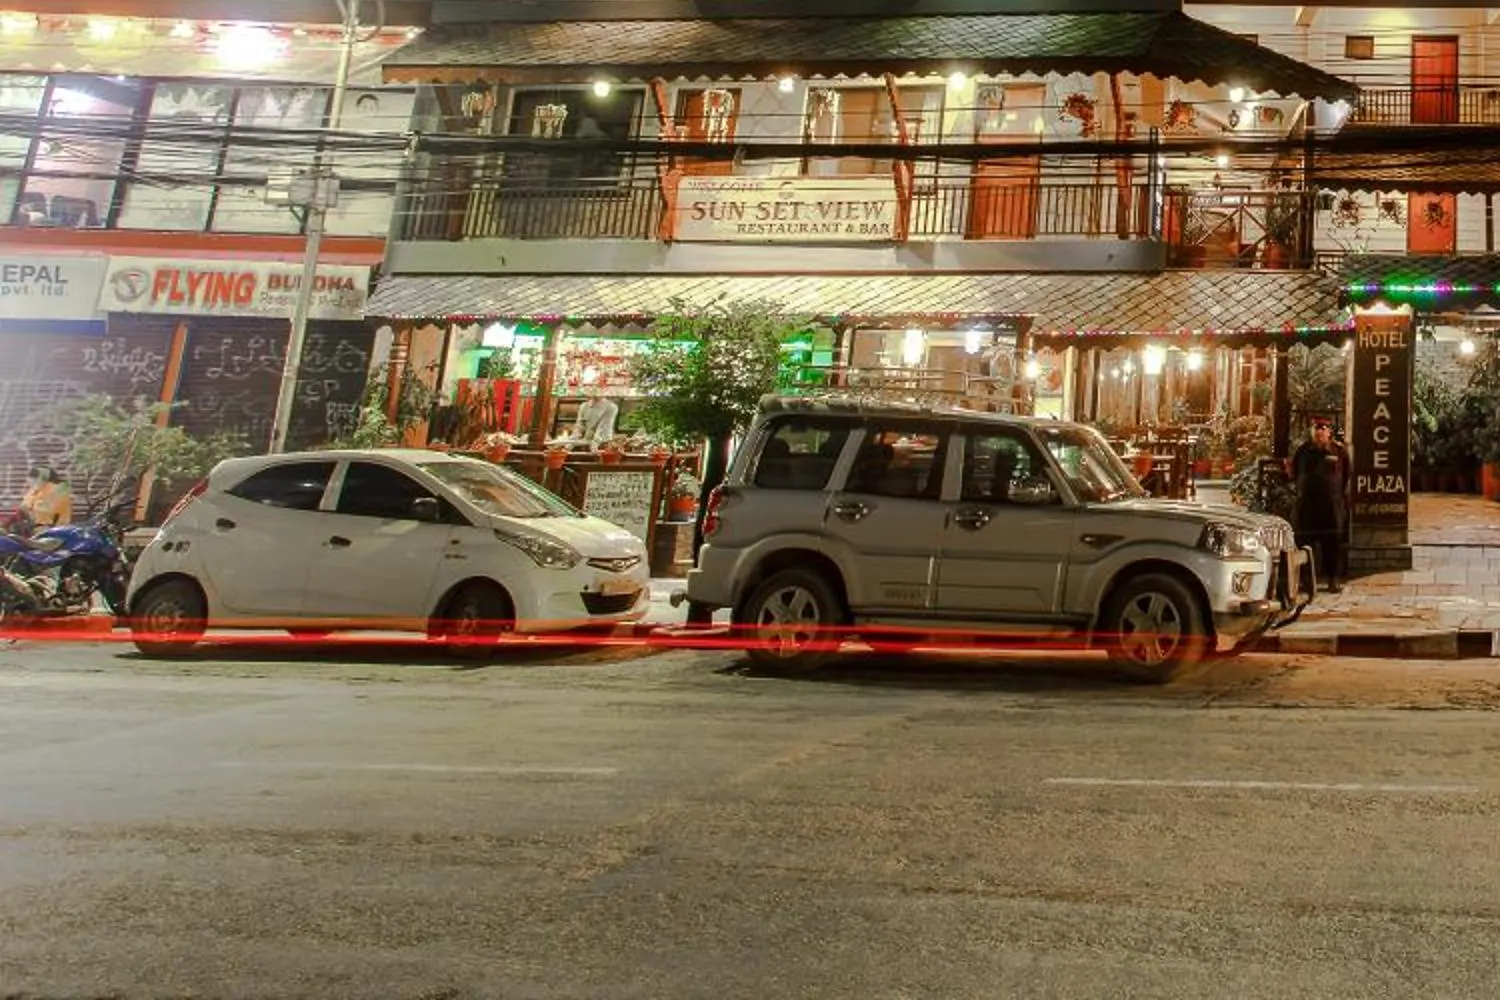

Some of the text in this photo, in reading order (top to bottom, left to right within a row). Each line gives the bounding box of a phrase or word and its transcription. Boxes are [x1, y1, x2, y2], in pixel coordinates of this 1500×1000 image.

[691, 201, 886, 221] SUN SET VIEW
[737, 222, 841, 235] RESTAURANT
[858, 222, 890, 234] BAR
[150, 268, 258, 308] FLYING
[1359, 331, 1407, 349] HOTEL
[1372, 354, 1392, 470] PEACE
[1357, 474, 1405, 494] PLAZA
